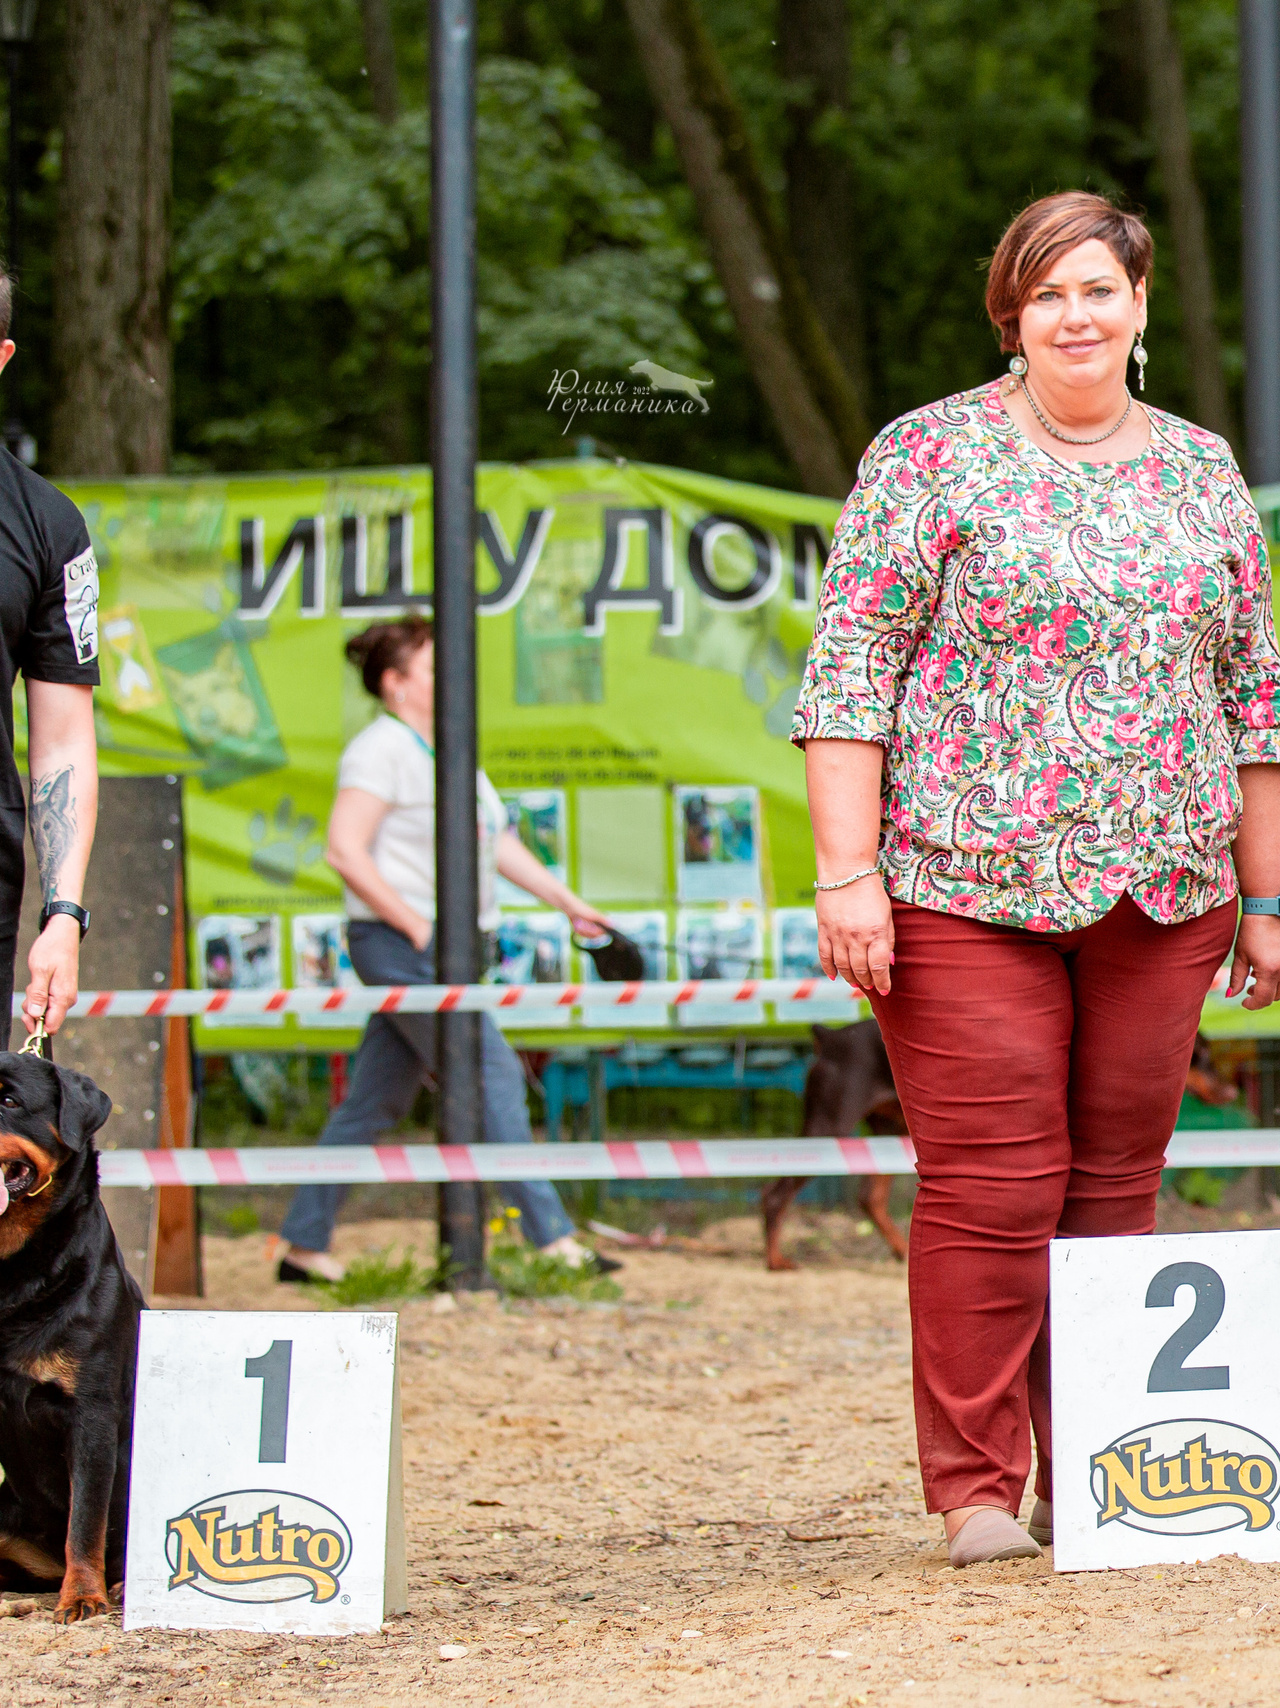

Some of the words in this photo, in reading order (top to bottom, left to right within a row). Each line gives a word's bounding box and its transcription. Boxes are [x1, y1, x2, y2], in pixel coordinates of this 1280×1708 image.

[1145, 1261, 1230, 1393] 2
[245, 1340, 292, 1463] 1
[1090, 1433, 1277, 1531] Nutro
[166, 1504, 345, 1603] Nutro
